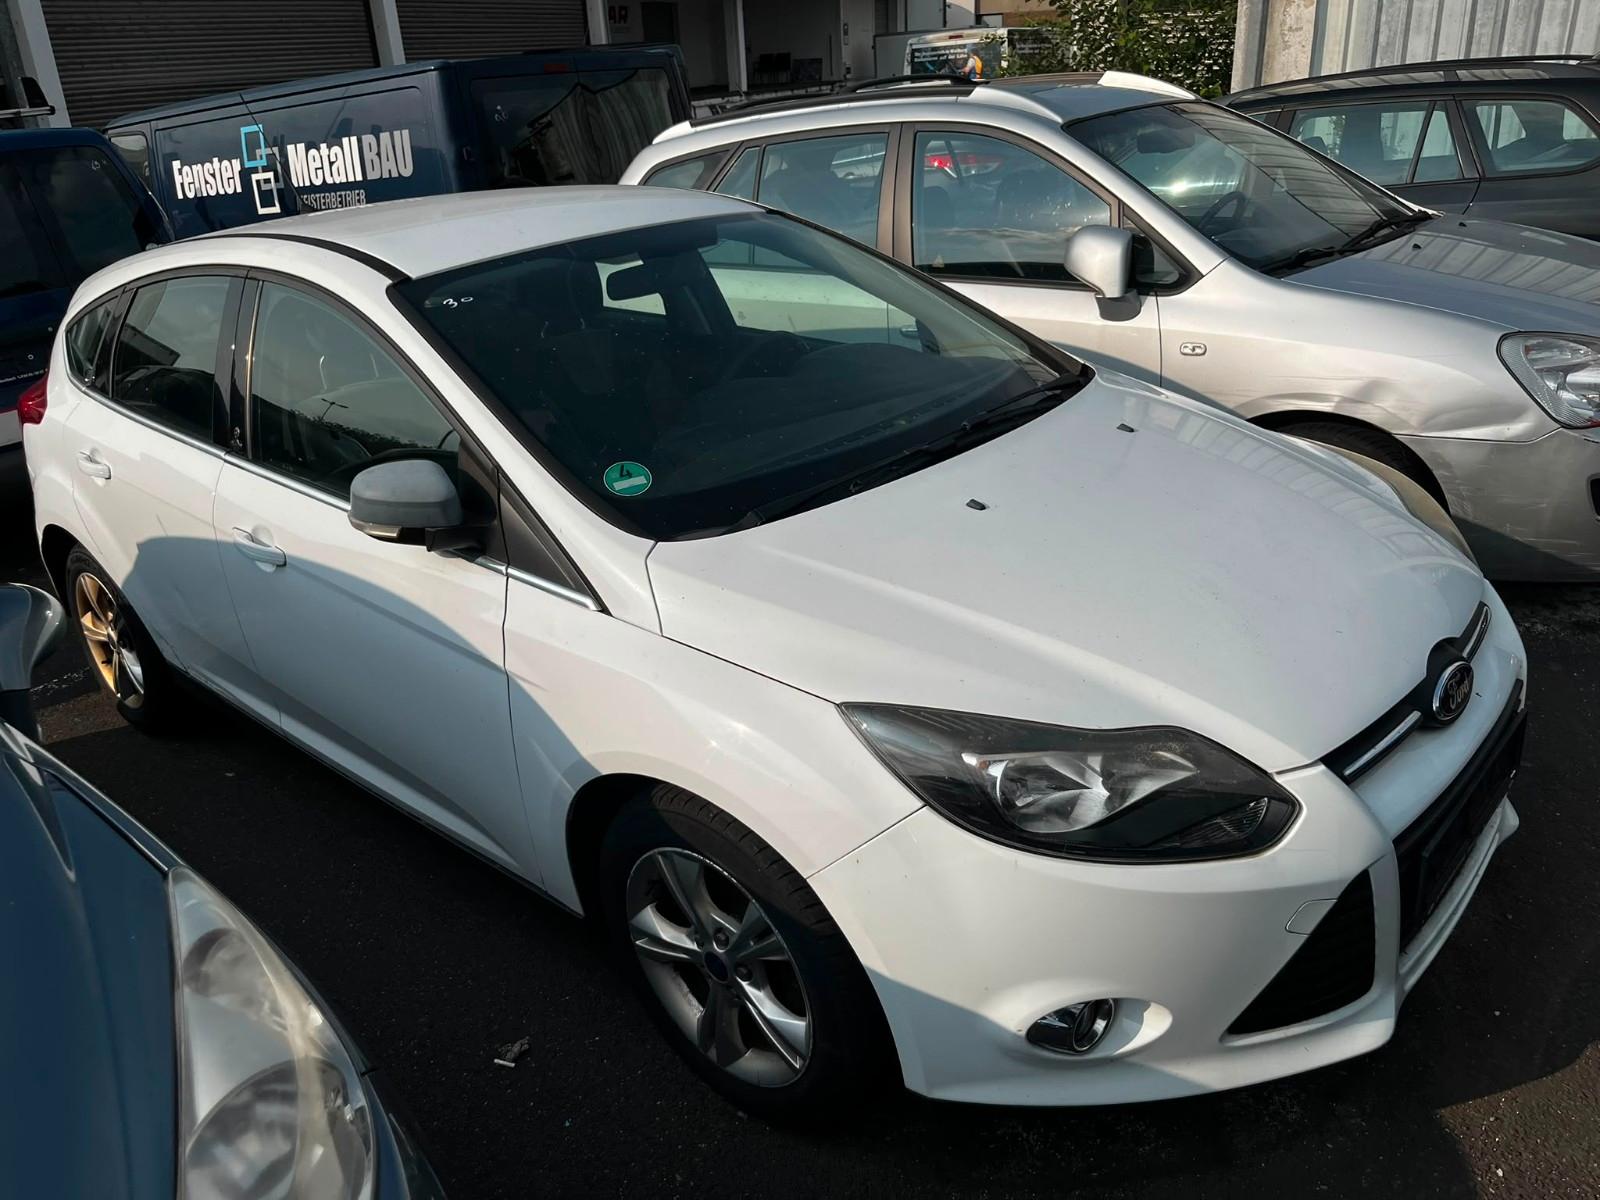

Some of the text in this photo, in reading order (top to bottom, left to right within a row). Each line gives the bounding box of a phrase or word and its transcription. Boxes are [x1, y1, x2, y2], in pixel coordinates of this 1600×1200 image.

[171, 156, 243, 200] Fenster
[300, 188, 367, 210] EISTERBETRIEB
[619, 462, 633, 479] 4
[1447, 672, 1470, 710] Ford
